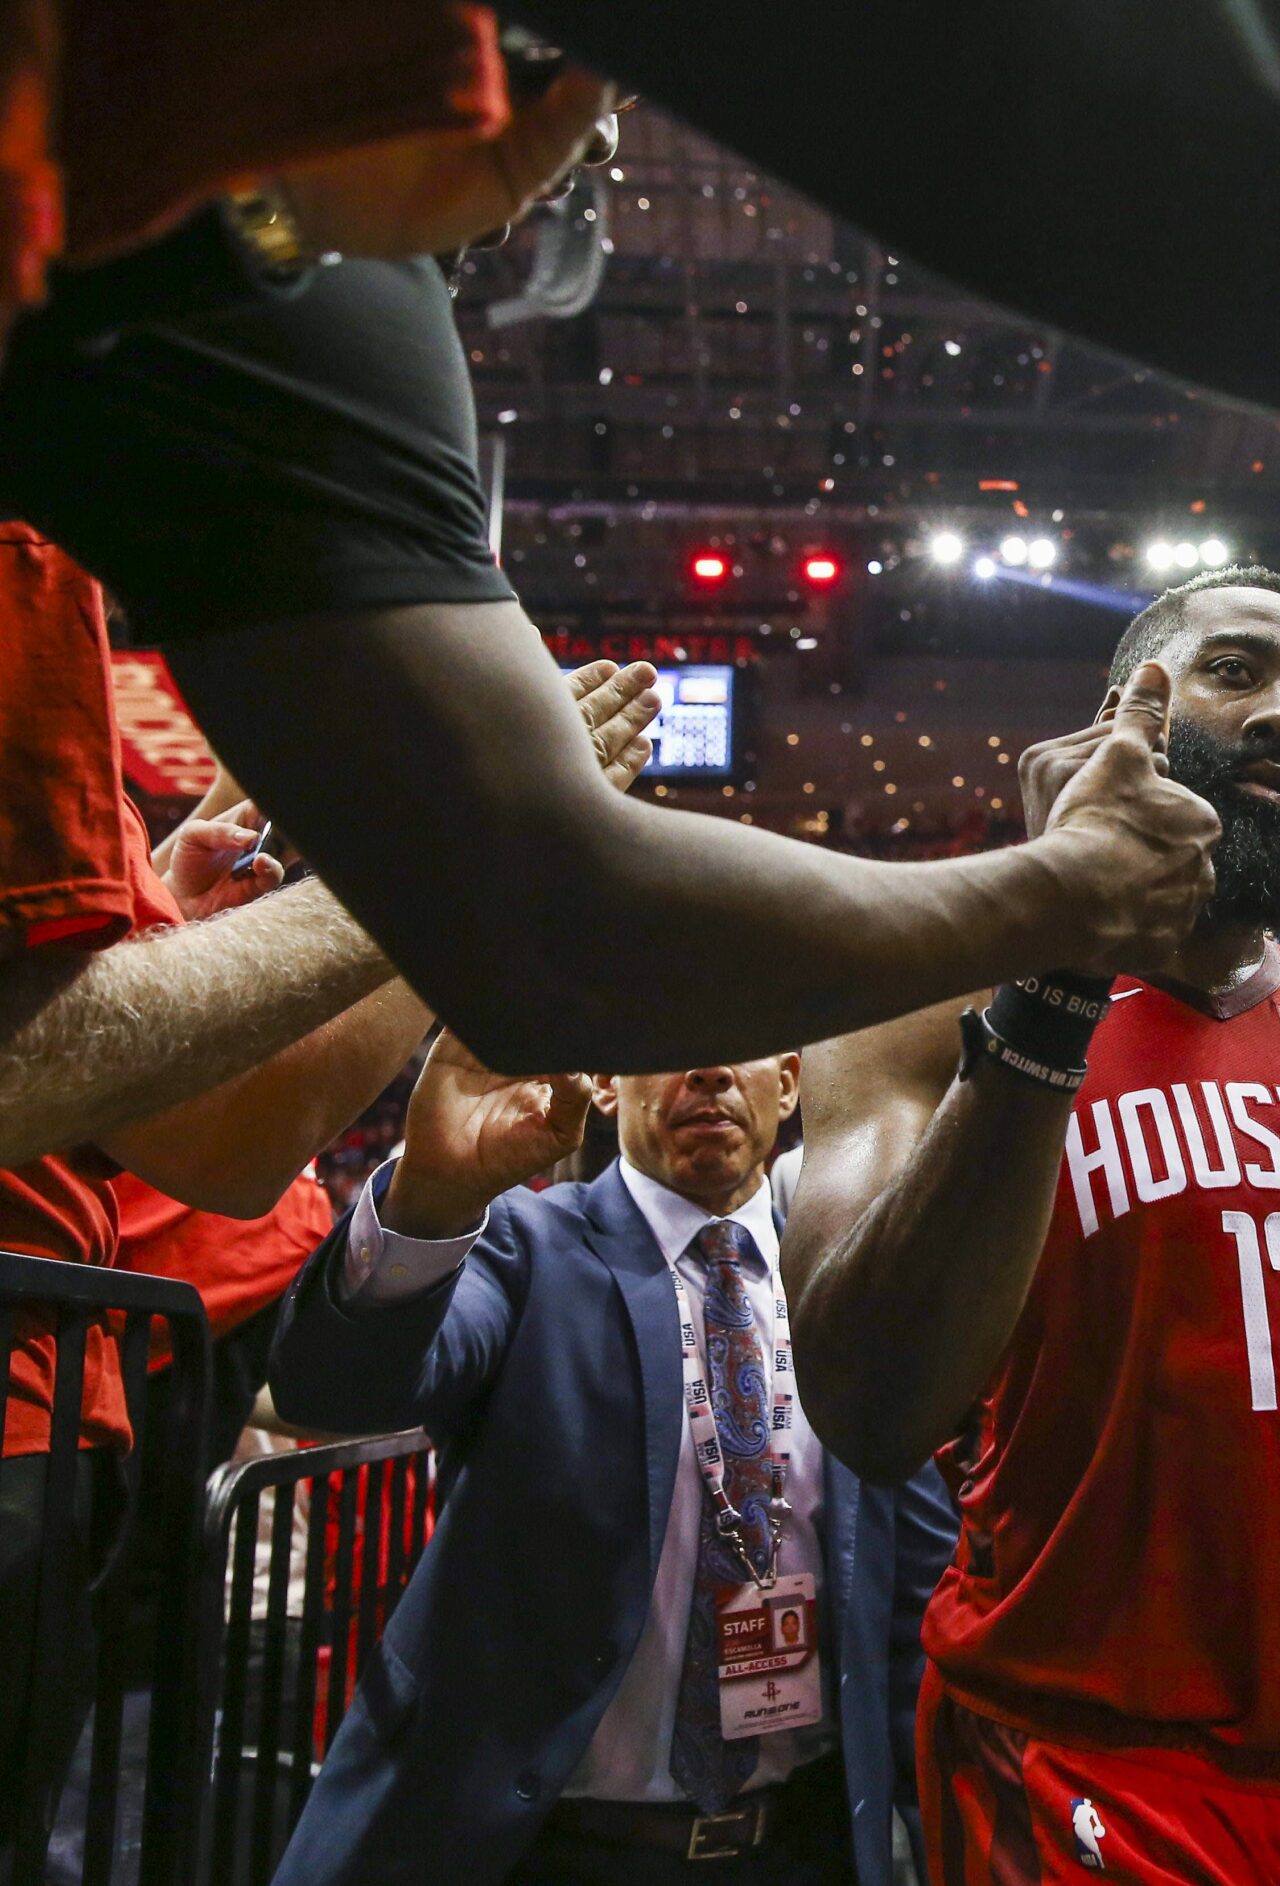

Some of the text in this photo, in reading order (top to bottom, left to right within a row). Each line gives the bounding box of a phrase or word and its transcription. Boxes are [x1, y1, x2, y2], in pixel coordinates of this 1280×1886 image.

[600, 634, 756, 661] CENTER
[1042, 985, 1063, 1006] IS
[1001, 1047, 1050, 1081] SWITCH
[776, 1299, 787, 1319] USA
[682, 1323, 697, 1346] USA
[775, 1349, 787, 1373] USA
[691, 1379, 707, 1405] USA
[772, 1405, 785, 1431] USA
[784, 1405, 793, 1430] TEAM
[704, 1438, 721, 1465] USA
[723, 1617, 766, 1636] STAFF
[725, 1656, 788, 1676] ALL-ACCESS
